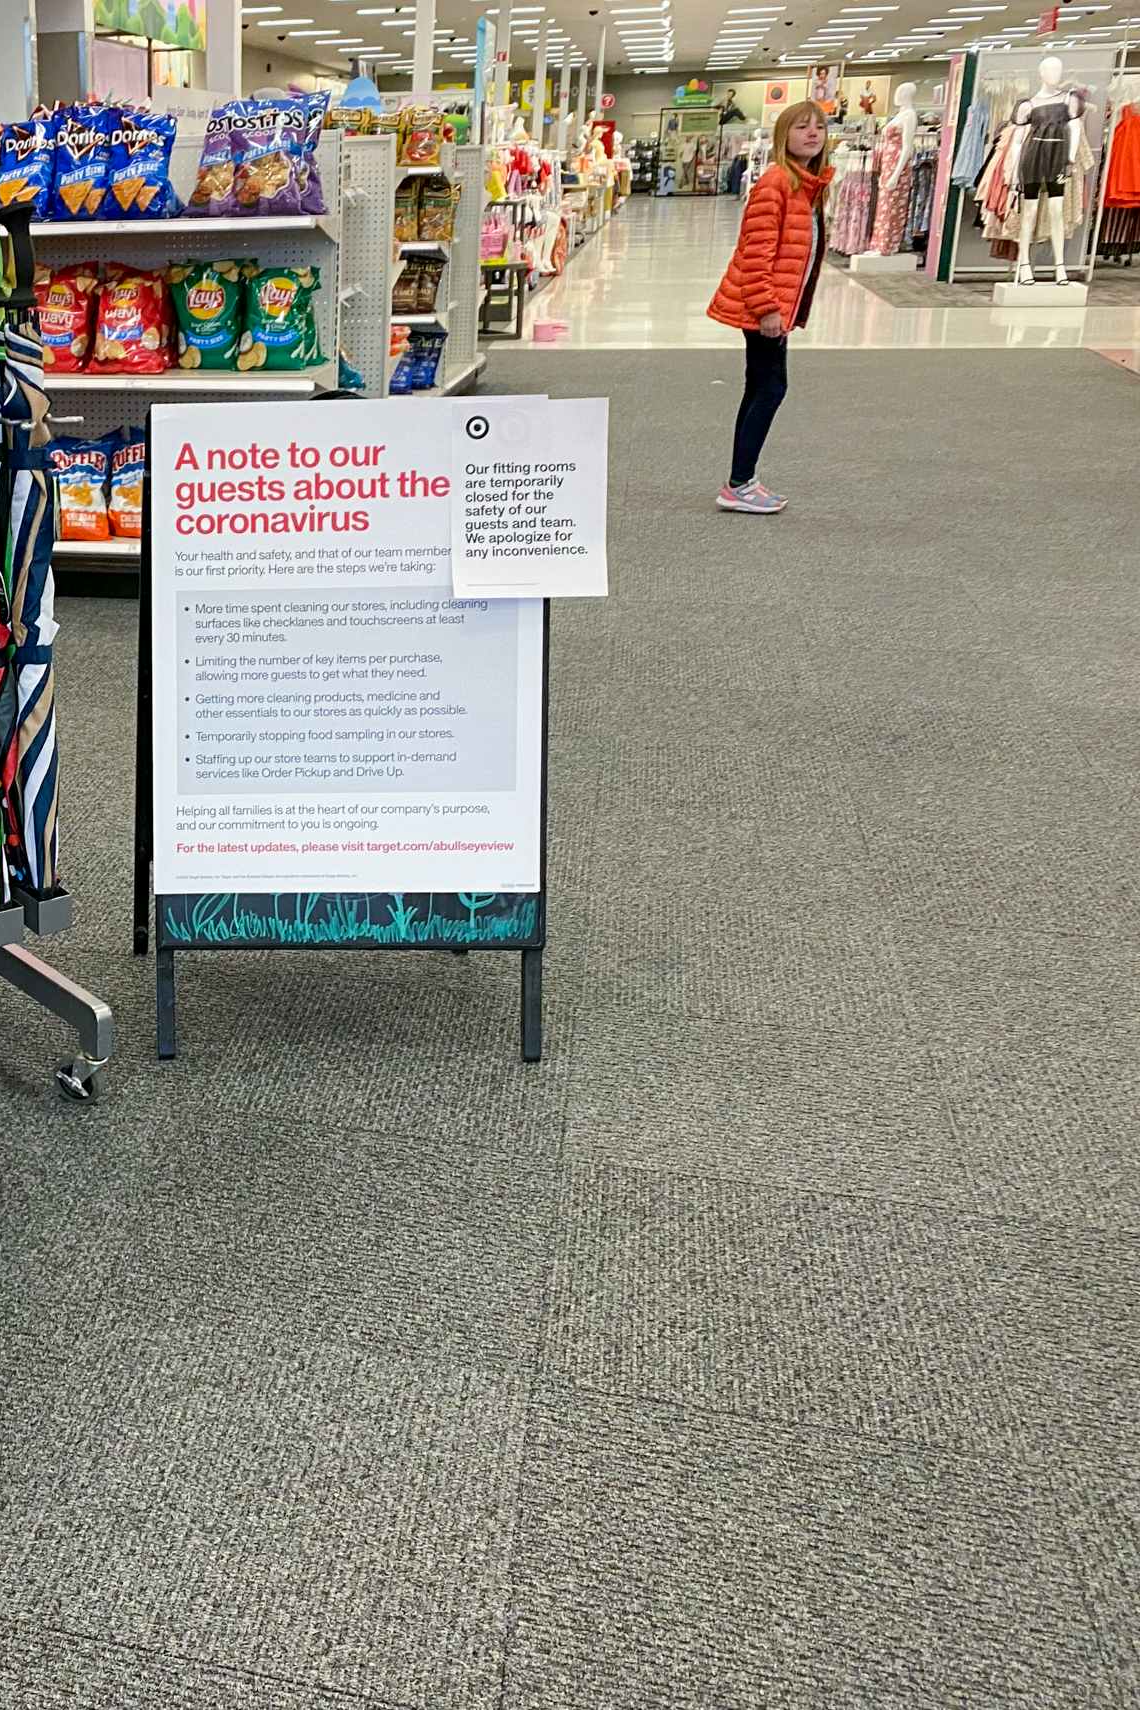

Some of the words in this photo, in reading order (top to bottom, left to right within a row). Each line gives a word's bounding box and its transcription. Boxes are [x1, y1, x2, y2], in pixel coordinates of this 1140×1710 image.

[174, 442, 199, 470] A
[207, 443, 280, 470] note
[287, 442, 320, 468] to
[329, 445, 385, 467] our
[465, 463, 489, 475] Our
[493, 462, 530, 476] fitting
[534, 462, 576, 472] rooms
[175, 475, 285, 510] guests
[293, 472, 390, 500] about
[396, 469, 450, 497] the
[464, 479, 486, 488] are
[490, 474, 564, 489] temporarily
[465, 490, 508, 502] closed
[511, 488, 530, 501] for
[533, 488, 554, 500] the
[175, 503, 369, 534] coronavirus
[465, 504, 505, 518] safety
[508, 503, 522, 515] of
[524, 505, 547, 514] our
[465, 519, 508, 532] guests
[511, 516, 536, 528] and
[540, 518, 576, 528] team.
[466, 530, 485, 543] We
[488, 531, 551, 545] apologize
[554, 529, 572, 541] for
[174, 551, 199, 561] Your
[200, 549, 233, 561] health
[235, 549, 256, 560] and
[258, 549, 292, 562] safety,
[294, 547, 315, 559] and
[317, 547, 338, 559] that
[340, 546, 353, 559] of
[354, 549, 372, 558] our
[374, 546, 403, 558] team
[465, 548, 488, 559] any
[492, 544, 588, 557] inconvenience.
[175, 565, 183, 576] is
[185, 567, 204, 576] our
[205, 565, 226, 575] first
[227, 563, 265, 577] priority.
[268, 563, 295, 574] Here
[296, 565, 314, 574] are
[316, 562, 334, 573] the
[335, 562, 366, 576] steps
[368, 560, 397, 572] we're
[400, 560, 436, 575] taking:
[195, 603, 222, 614] More
[225, 601, 249, 614] time
[250, 602, 281, 616] spent
[283, 600, 329, 616] cleaning
[330, 602, 350, 612] our
[351, 599, 387, 615] stores,
[389, 599, 440, 612] including
[441, 597, 488, 611] cleaning
[195, 616, 241, 629] surfaces
[242, 615, 261, 628] like
[262, 614, 324, 627] checklanes
[325, 614, 347, 626] and
[349, 613, 424, 626] touchscreens
[424, 614, 436, 624] at
[438, 613, 464, 624] least
[194, 633, 225, 645] every
[226, 631, 241, 643] 30
[241, 631, 286, 642] minutes.
[195, 730, 256, 744] Temporarily
[258, 729, 306, 744] stopping
[308, 728, 332, 740] food
[334, 728, 384, 742] sampling
[386, 728, 396, 739] in
[397, 730, 417, 739] our
[418, 727, 454, 738] stores.
[176, 842, 195, 853] For
[196, 842, 214, 853] the
[217, 842, 248, 853] latest
[250, 841, 299, 854] updates,
[301, 841, 339, 853] please
[341, 840, 364, 851] visit
[366, 840, 514, 853] target.com/abullseyeview
